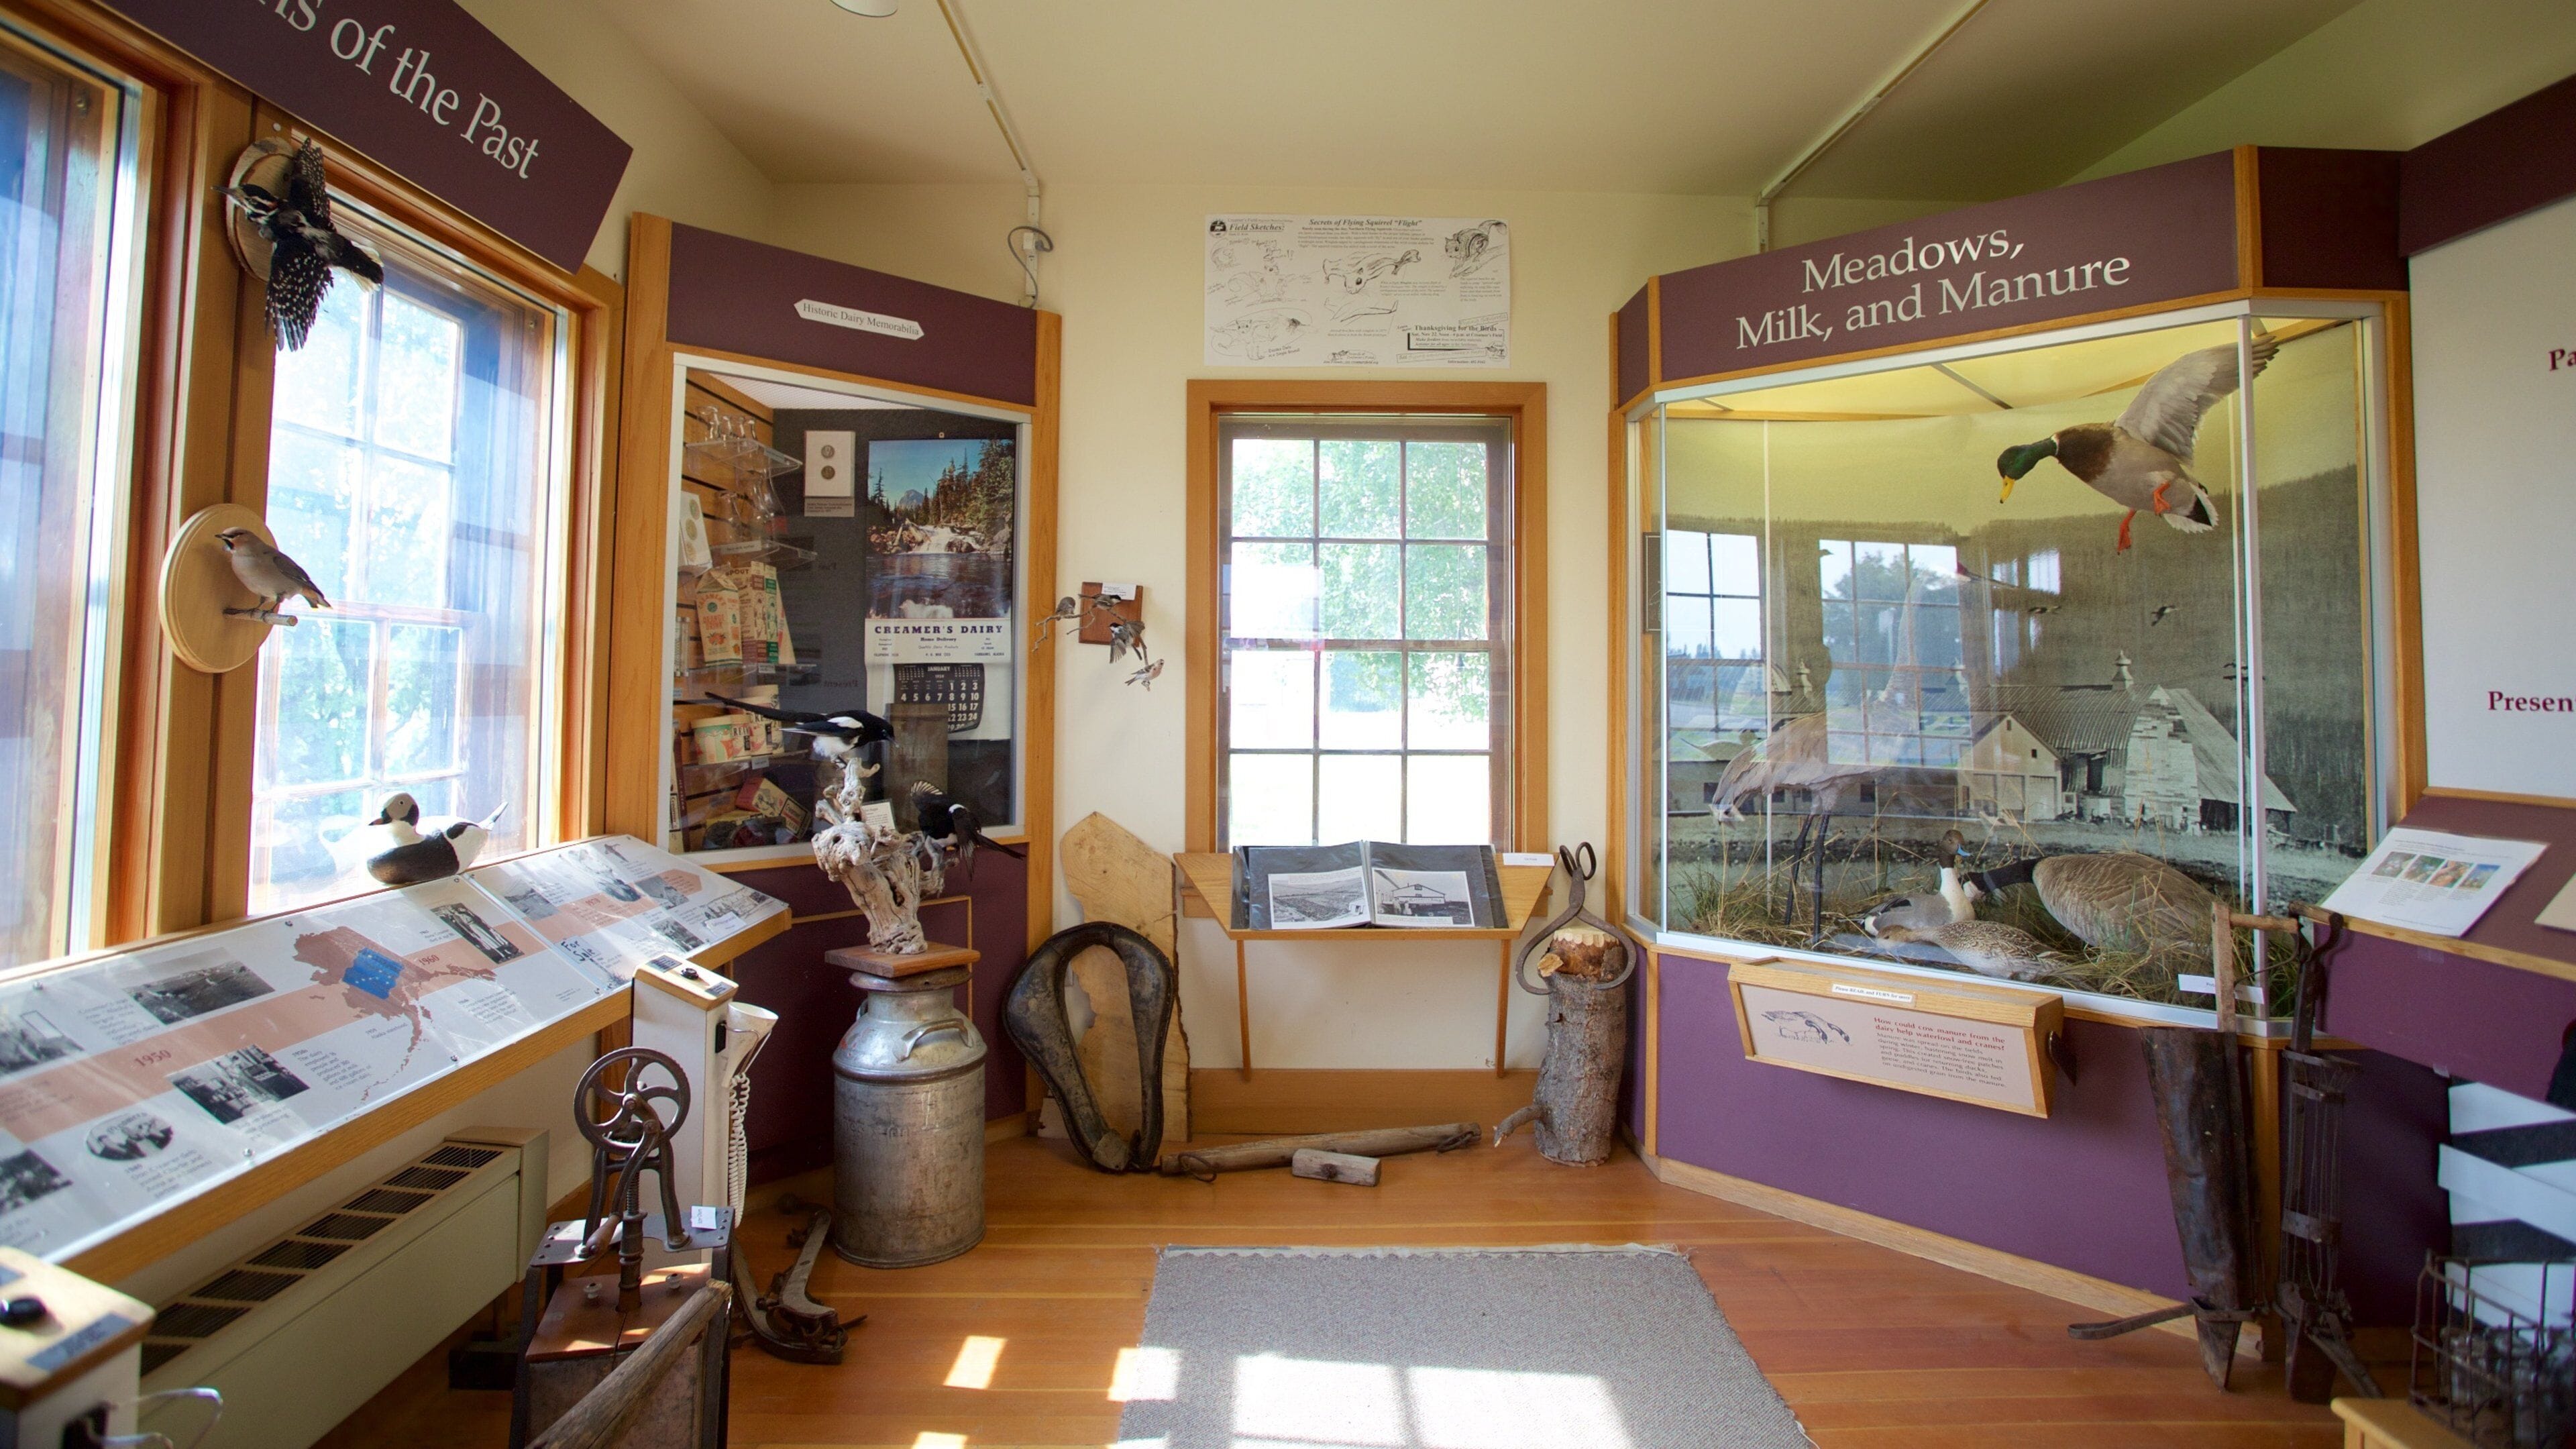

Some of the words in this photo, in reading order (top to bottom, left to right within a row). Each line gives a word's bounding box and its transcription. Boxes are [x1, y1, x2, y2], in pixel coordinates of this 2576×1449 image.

[330, 18, 396, 75] of
[389, 47, 460, 125] the
[460, 93, 539, 179] Past
[1229, 223, 1248, 231] Field
[1250, 223, 1285, 231] Sketches:
[1334, 219, 1342, 227] of
[1342, 219, 1364, 227] Flying
[1801, 229, 2025, 293] Meadows,
[1735, 303, 1833, 350] Milk,
[1845, 284, 1924, 331] and
[1937, 255, 2131, 315] Manure
[803, 303, 838, 319] Historic
[841, 311, 865, 326] Dairy
[867, 317, 920, 335] Memorabilia
[2548, 348, 2576, 372] Pa
[874, 625, 953, 634] CREAMER'S
[961, 625, 1003, 634] DAIRY
[950, 682, 954, 690] 1
[960, 682, 967, 690] 2
[972, 682, 978, 690] 3
[900, 693, 907, 702] 4
[913, 693, 919, 702] 5
[924, 693, 931, 702] 6
[936, 693, 943, 702] 7
[949, 693, 955, 702] 8
[960, 693, 966, 701] 9
[971, 693, 979, 701] 10
[2487, 691, 2576, 712] Presen
[947, 703, 957, 711] 15
[959, 703, 967, 711] 16
[969, 702, 979, 711] 17
[957, 713, 967, 722] 23
[968, 712, 978, 720] 24
[561, 940, 580, 952] For
[419, 954, 440, 966] 1960
[572, 948, 596, 961] Sale
[1874, 1017, 1891, 1025] How
[1894, 1021, 1915, 1029] could
[1937, 1028, 1967, 1037] manure
[1970, 1033, 1989, 1041] from
[1875, 1024, 1894, 1032] dairy
[1897, 1028, 1913, 1036] help
[1915, 1032, 1954, 1042] waterfowl
[1975, 1042, 2004, 1051] cranes?
[1878, 1039, 1898, 1047] during
[1925, 1046, 1957, 1057] hastening
[134, 1049, 172, 1067] 1950
[1933, 1060, 1964, 1070] returning
[1943, 1055, 1976, 1065] snow-free
[1978, 1061, 2004, 1070] patches
[1893, 1064, 1927, 1073] undigested
[1979, 1079, 2007, 1087] manure.
